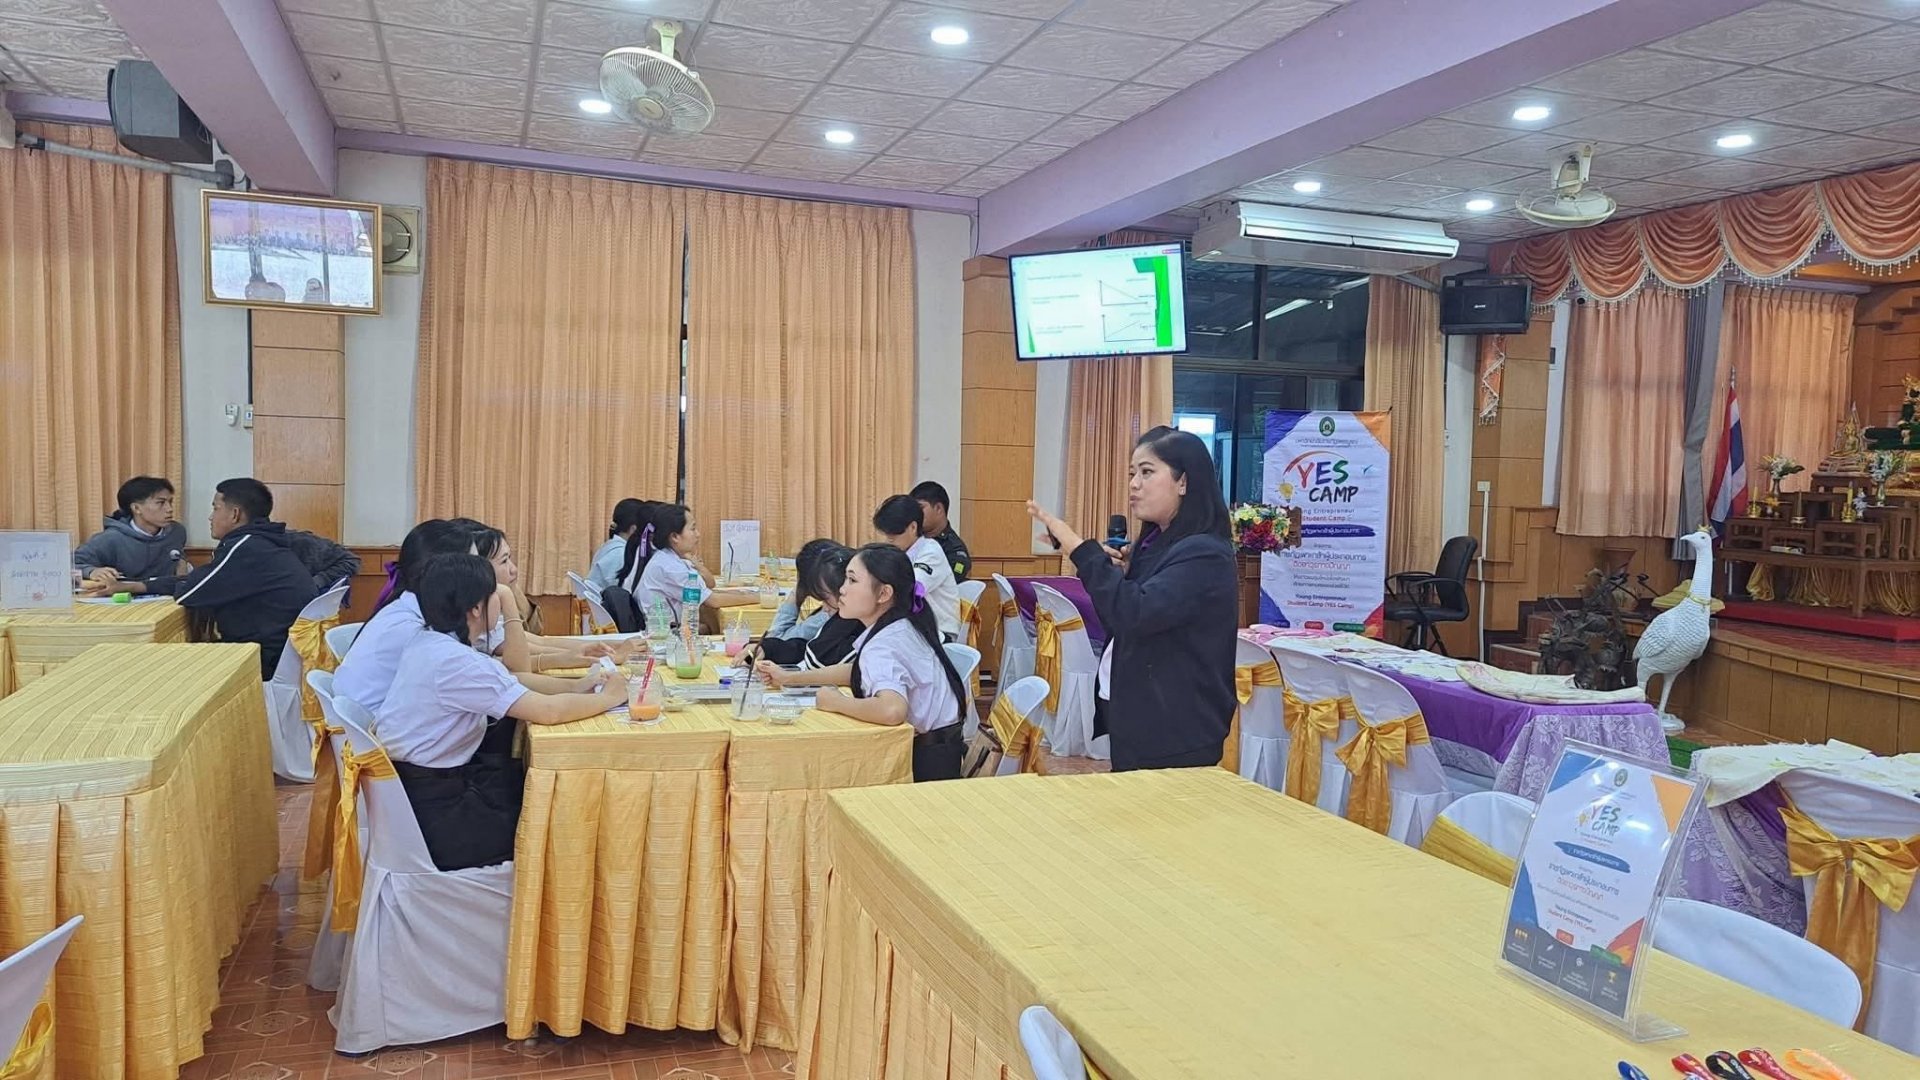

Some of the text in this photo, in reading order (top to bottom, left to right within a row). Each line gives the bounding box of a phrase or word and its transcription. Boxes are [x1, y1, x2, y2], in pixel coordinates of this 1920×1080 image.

[1297, 460, 1349, 489] YES
[1309, 486, 1359, 504] CAMP
[1590, 804, 1622, 823] YES
[1592, 820, 1620, 837] CAMP
